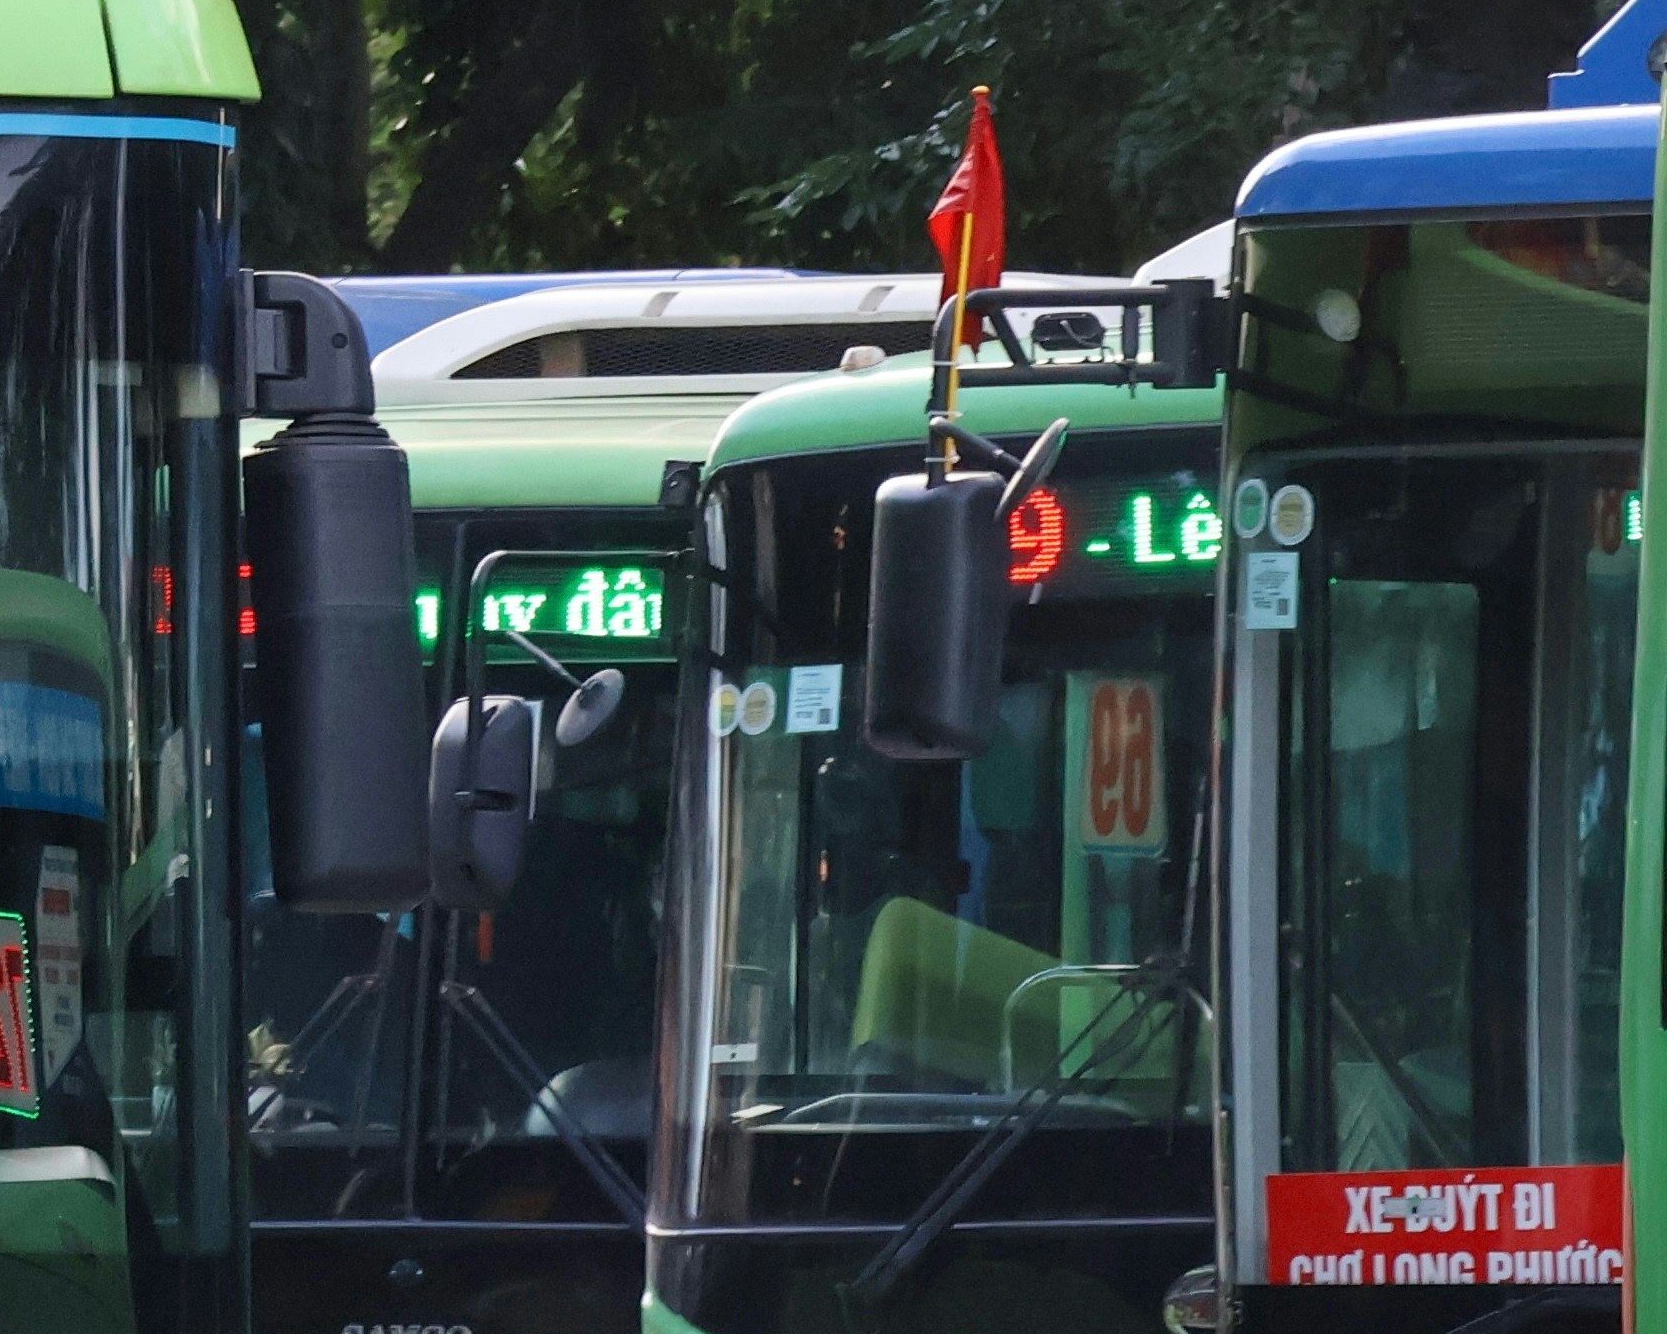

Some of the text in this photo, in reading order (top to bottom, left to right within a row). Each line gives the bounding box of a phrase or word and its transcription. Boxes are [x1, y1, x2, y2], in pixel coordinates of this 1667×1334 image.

[1133, 493, 1224, 564] Lê
[1345, 1185, 1395, 1233] XE
[1513, 1182, 1557, 1230] ĐI
